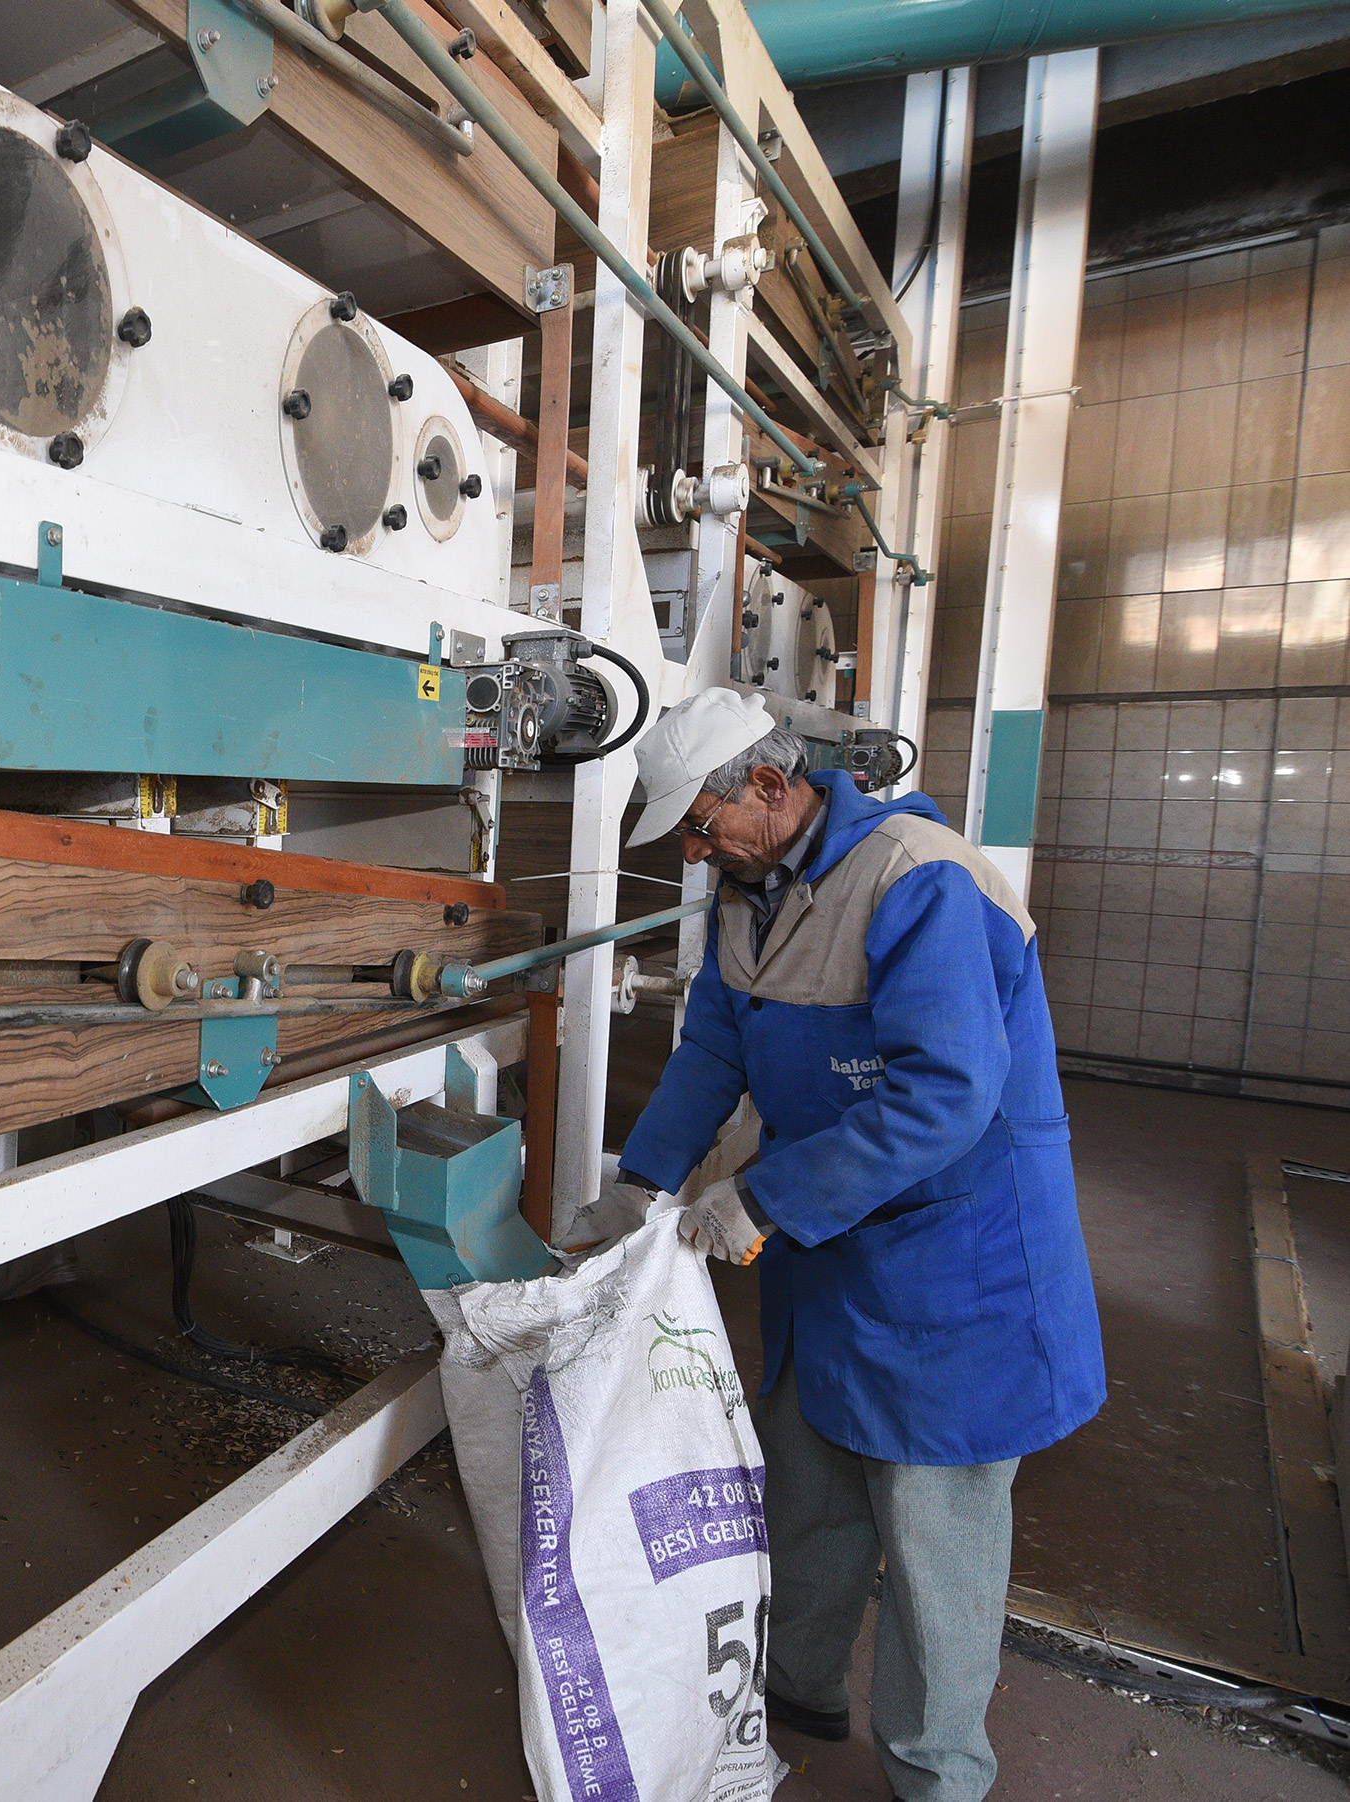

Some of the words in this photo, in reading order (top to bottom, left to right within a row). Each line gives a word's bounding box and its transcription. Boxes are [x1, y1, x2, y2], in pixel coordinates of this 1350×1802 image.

[830, 1055, 886, 1074] Balcıl
[525, 1388, 545, 1463] KONYA
[530, 1468, 558, 1550] ŞEKER
[688, 1486, 719, 1508] 42
[723, 1482, 745, 1505] 08
[746, 1480, 763, 1504] B
[651, 1520, 698, 1564] BESİ
[703, 1513, 765, 1545] GELİŞT
[543, 1555, 560, 1606] YEM
[549, 1637, 573, 1676] BESİ
[576, 1675, 594, 1700] 42
[583, 1705, 601, 1730] 08
[559, 1681, 602, 1797] GELİŞTİRME
[593, 1736, 608, 1749] B
